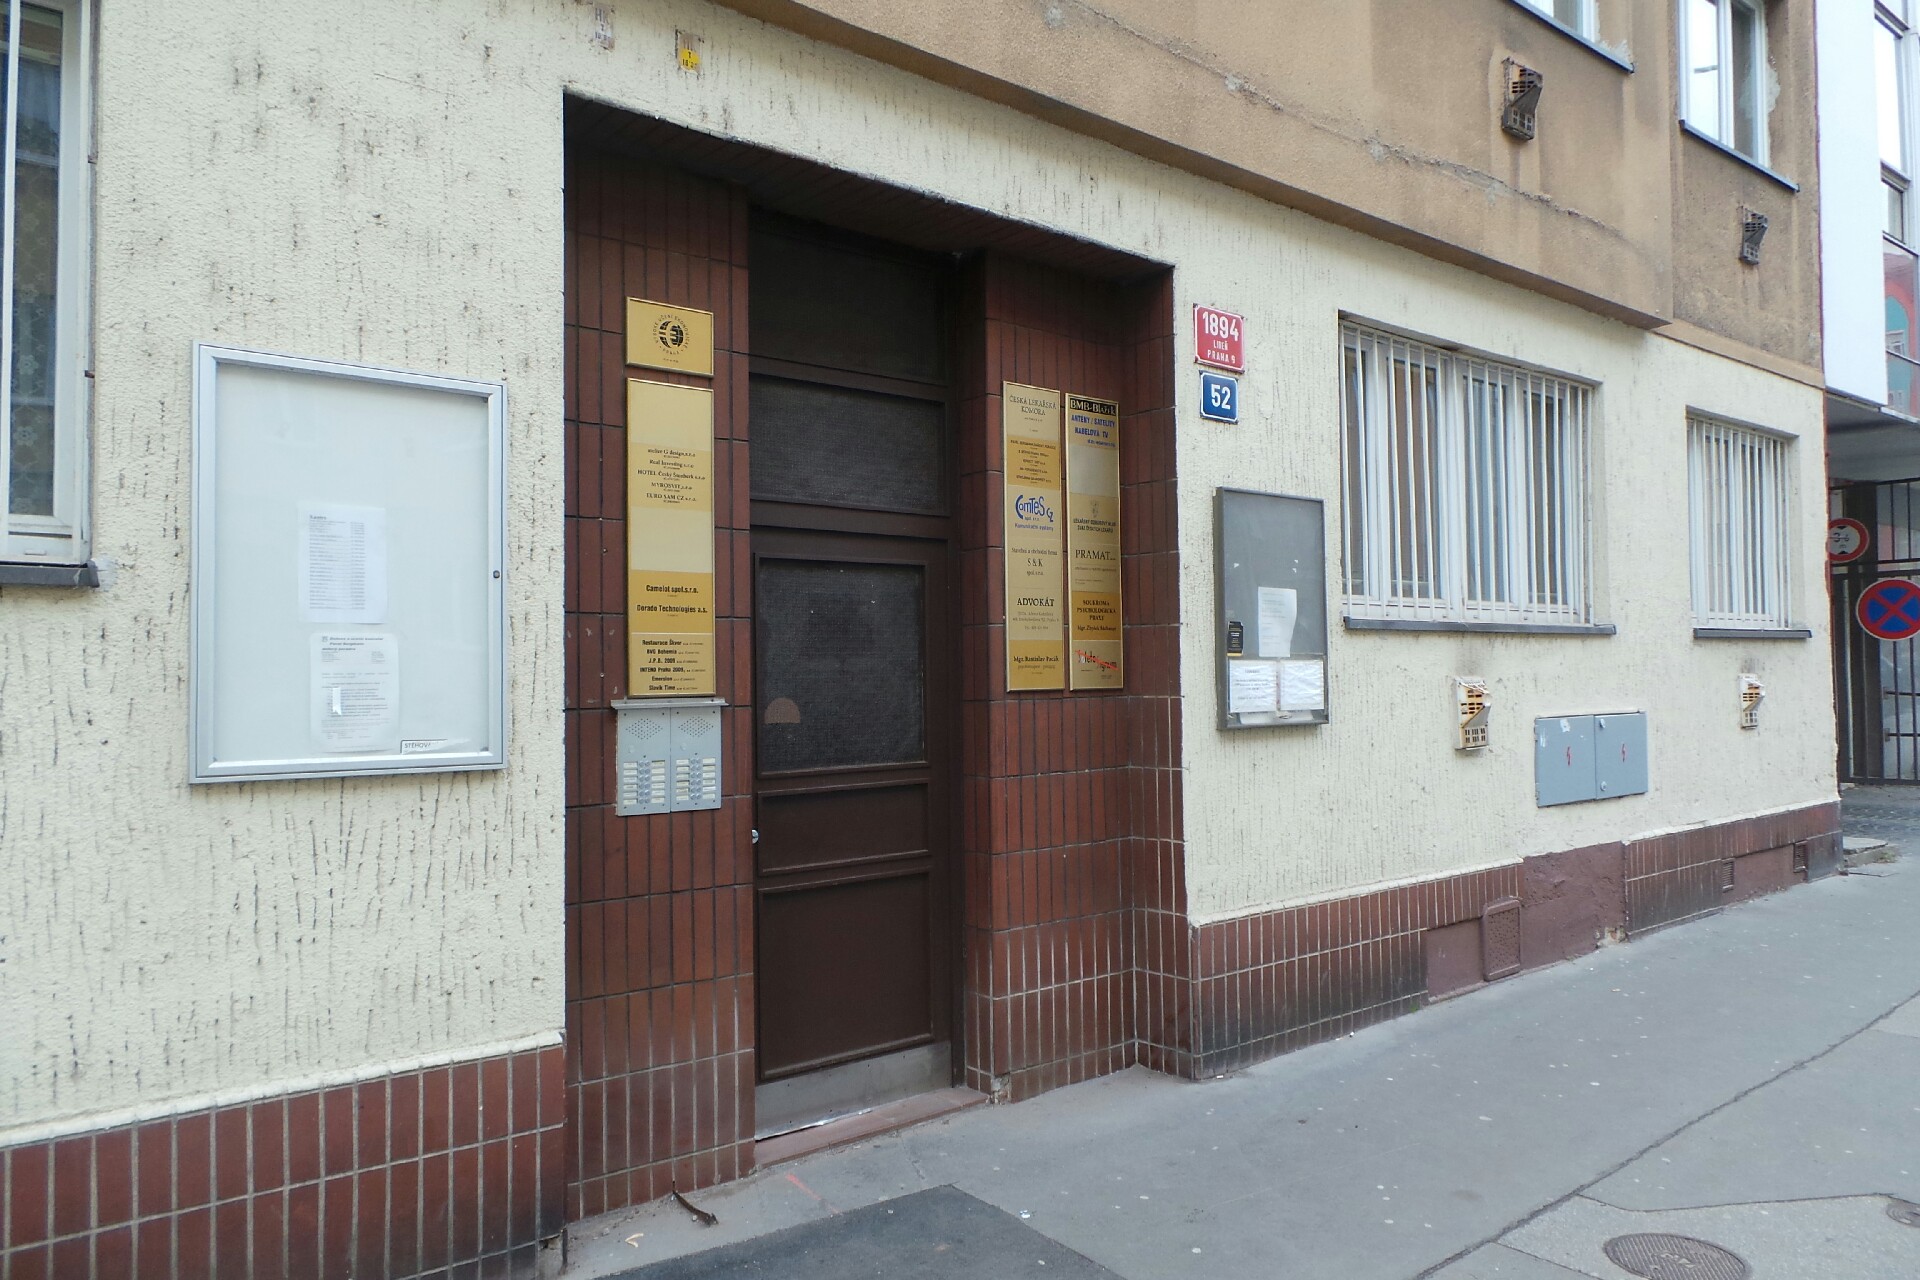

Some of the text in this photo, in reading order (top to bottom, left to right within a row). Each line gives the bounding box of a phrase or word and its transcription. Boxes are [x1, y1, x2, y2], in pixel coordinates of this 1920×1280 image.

[1203, 312, 1239, 341] 1894
[1214, 340, 1228, 351] LIBEŇ
[1208, 350, 1235, 364] PRAHA 9
[1211, 384, 1230, 410] 52
[1071, 415, 1090, 424] ANTENY
[1076, 549, 1110, 560] PRAMAT
[1028, 558, 1031, 566] S
[1038, 559, 1043, 567] K
[1017, 597, 1054, 606] ADVOKÁT
[659, 605, 696, 613] Technologies
